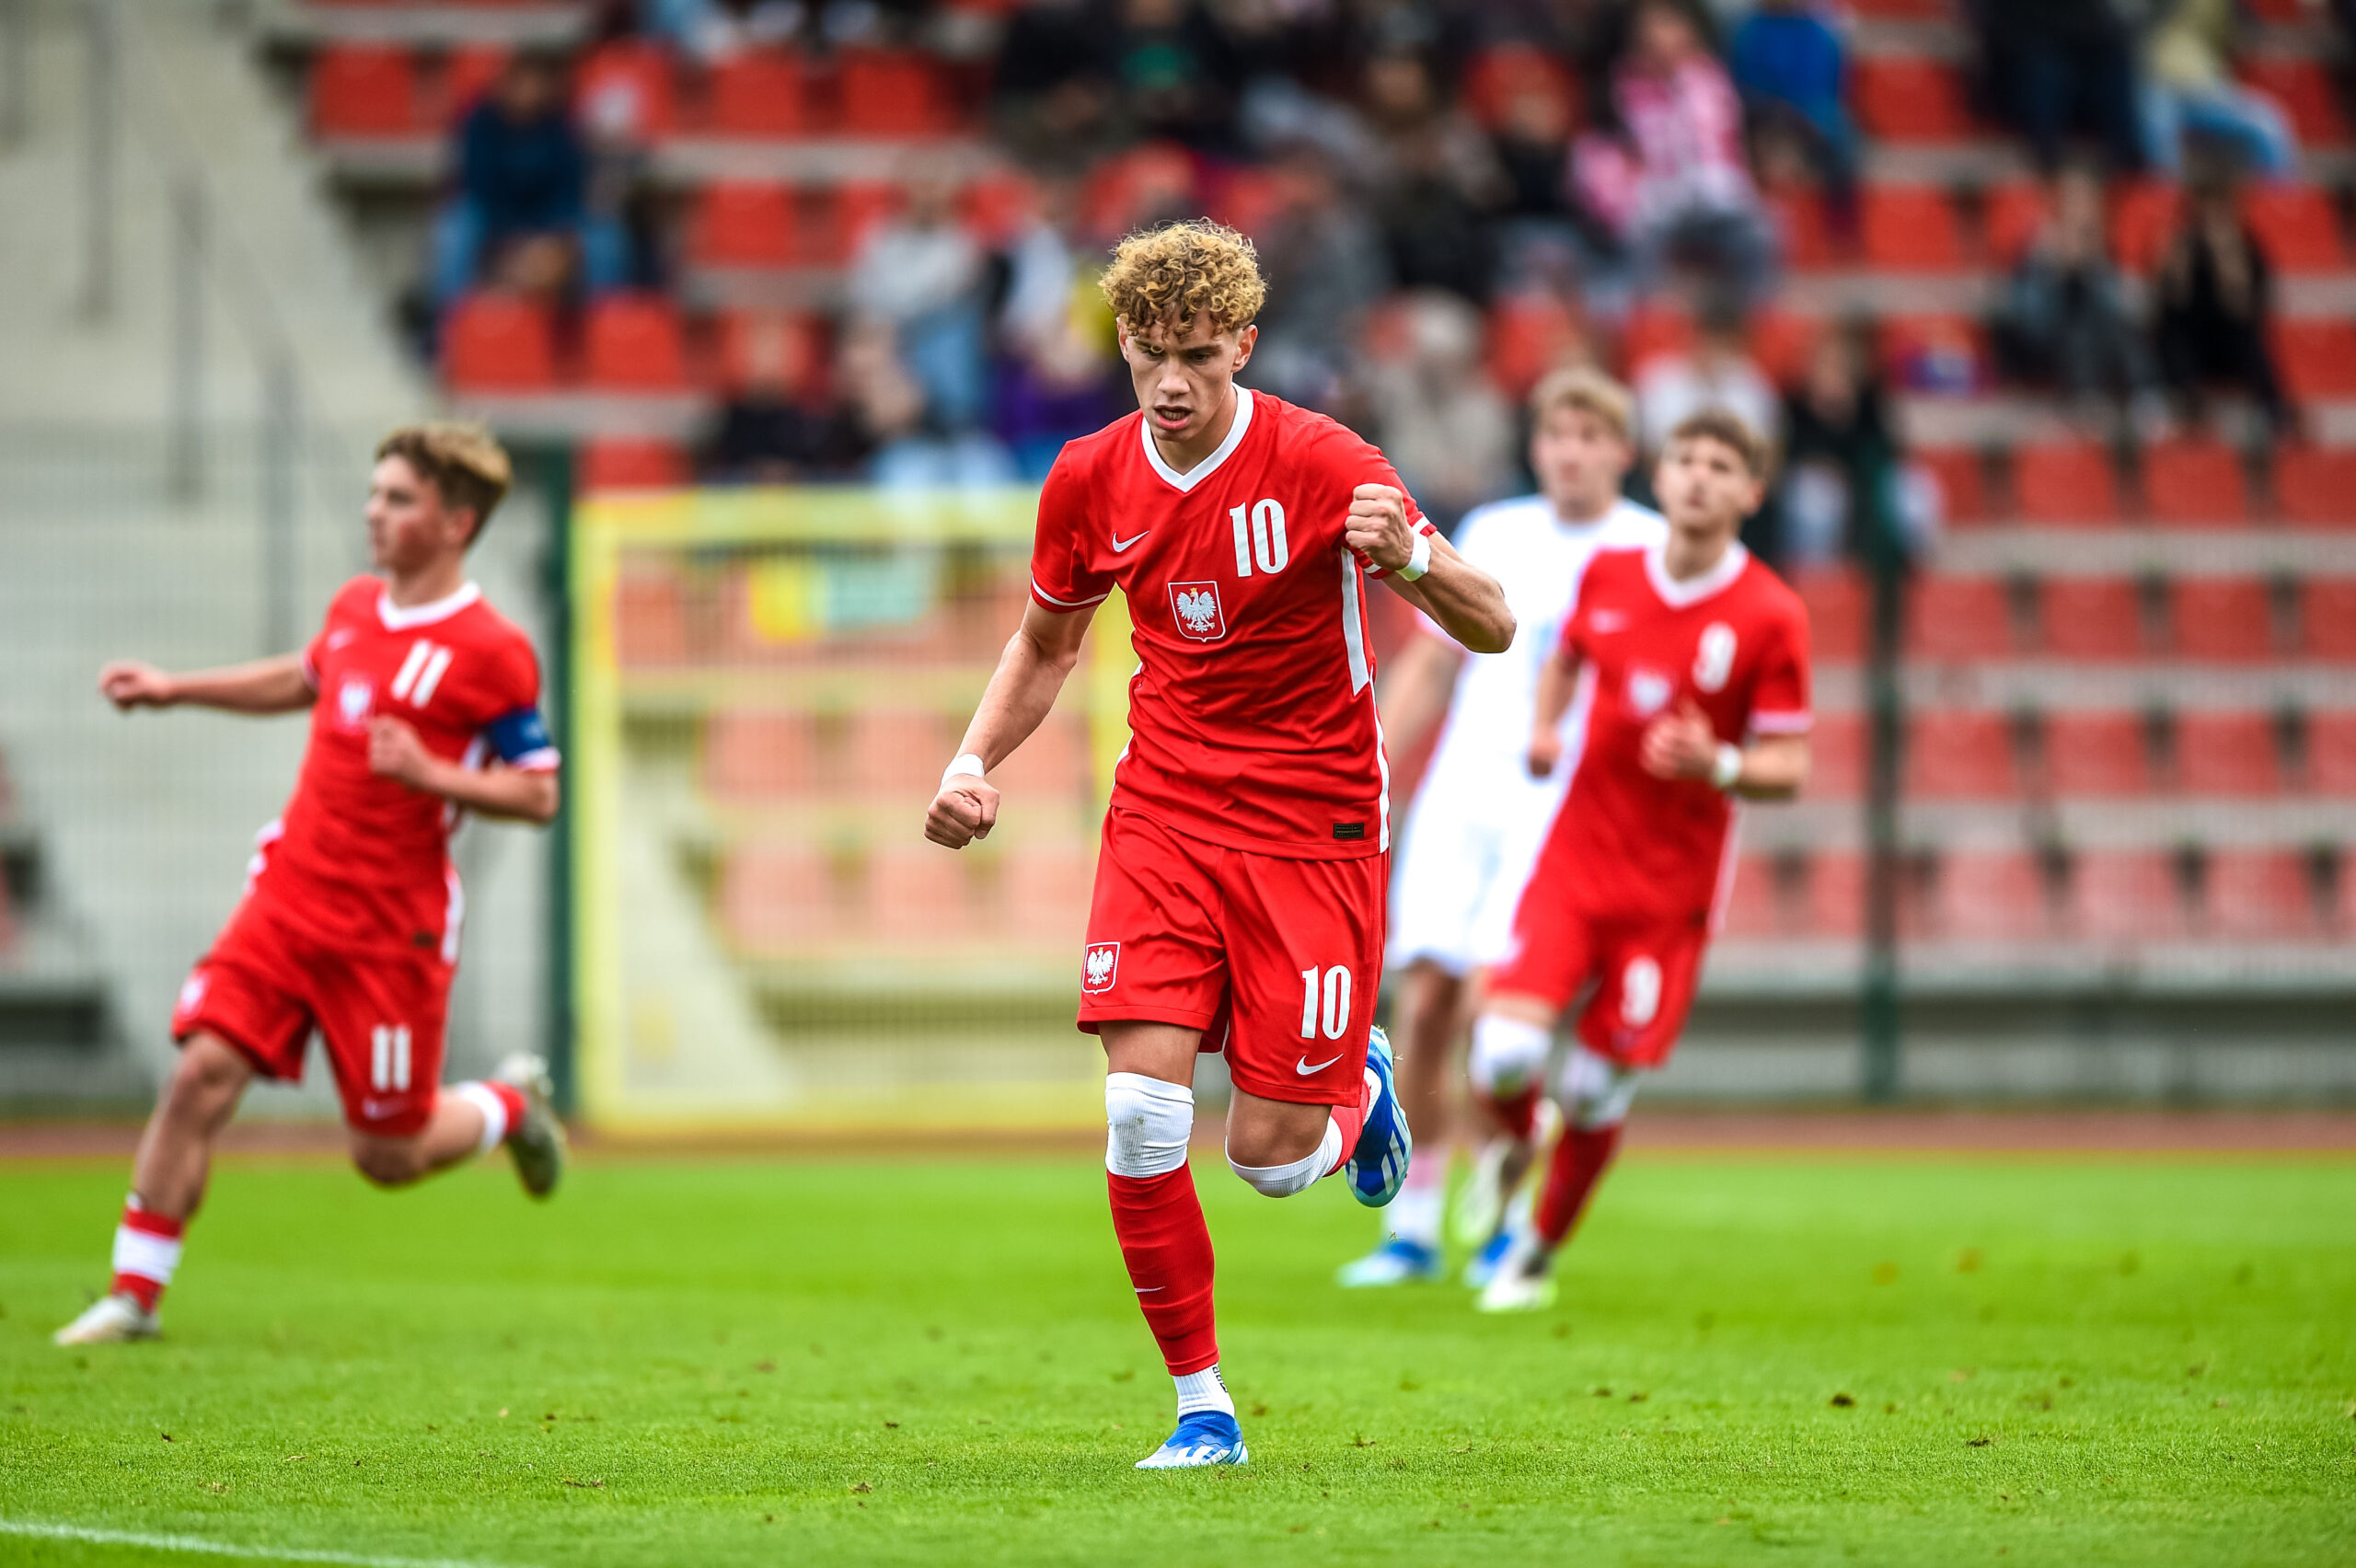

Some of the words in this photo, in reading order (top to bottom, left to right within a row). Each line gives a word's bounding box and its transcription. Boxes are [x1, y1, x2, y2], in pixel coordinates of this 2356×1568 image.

[1229, 498, 1289, 577] 10
[391, 640, 451, 708] 11
[1694, 622, 1737, 693] 9
[1300, 964, 1352, 1040] 10
[1621, 955, 1661, 1025] 9
[372, 1025, 410, 1091] 11
